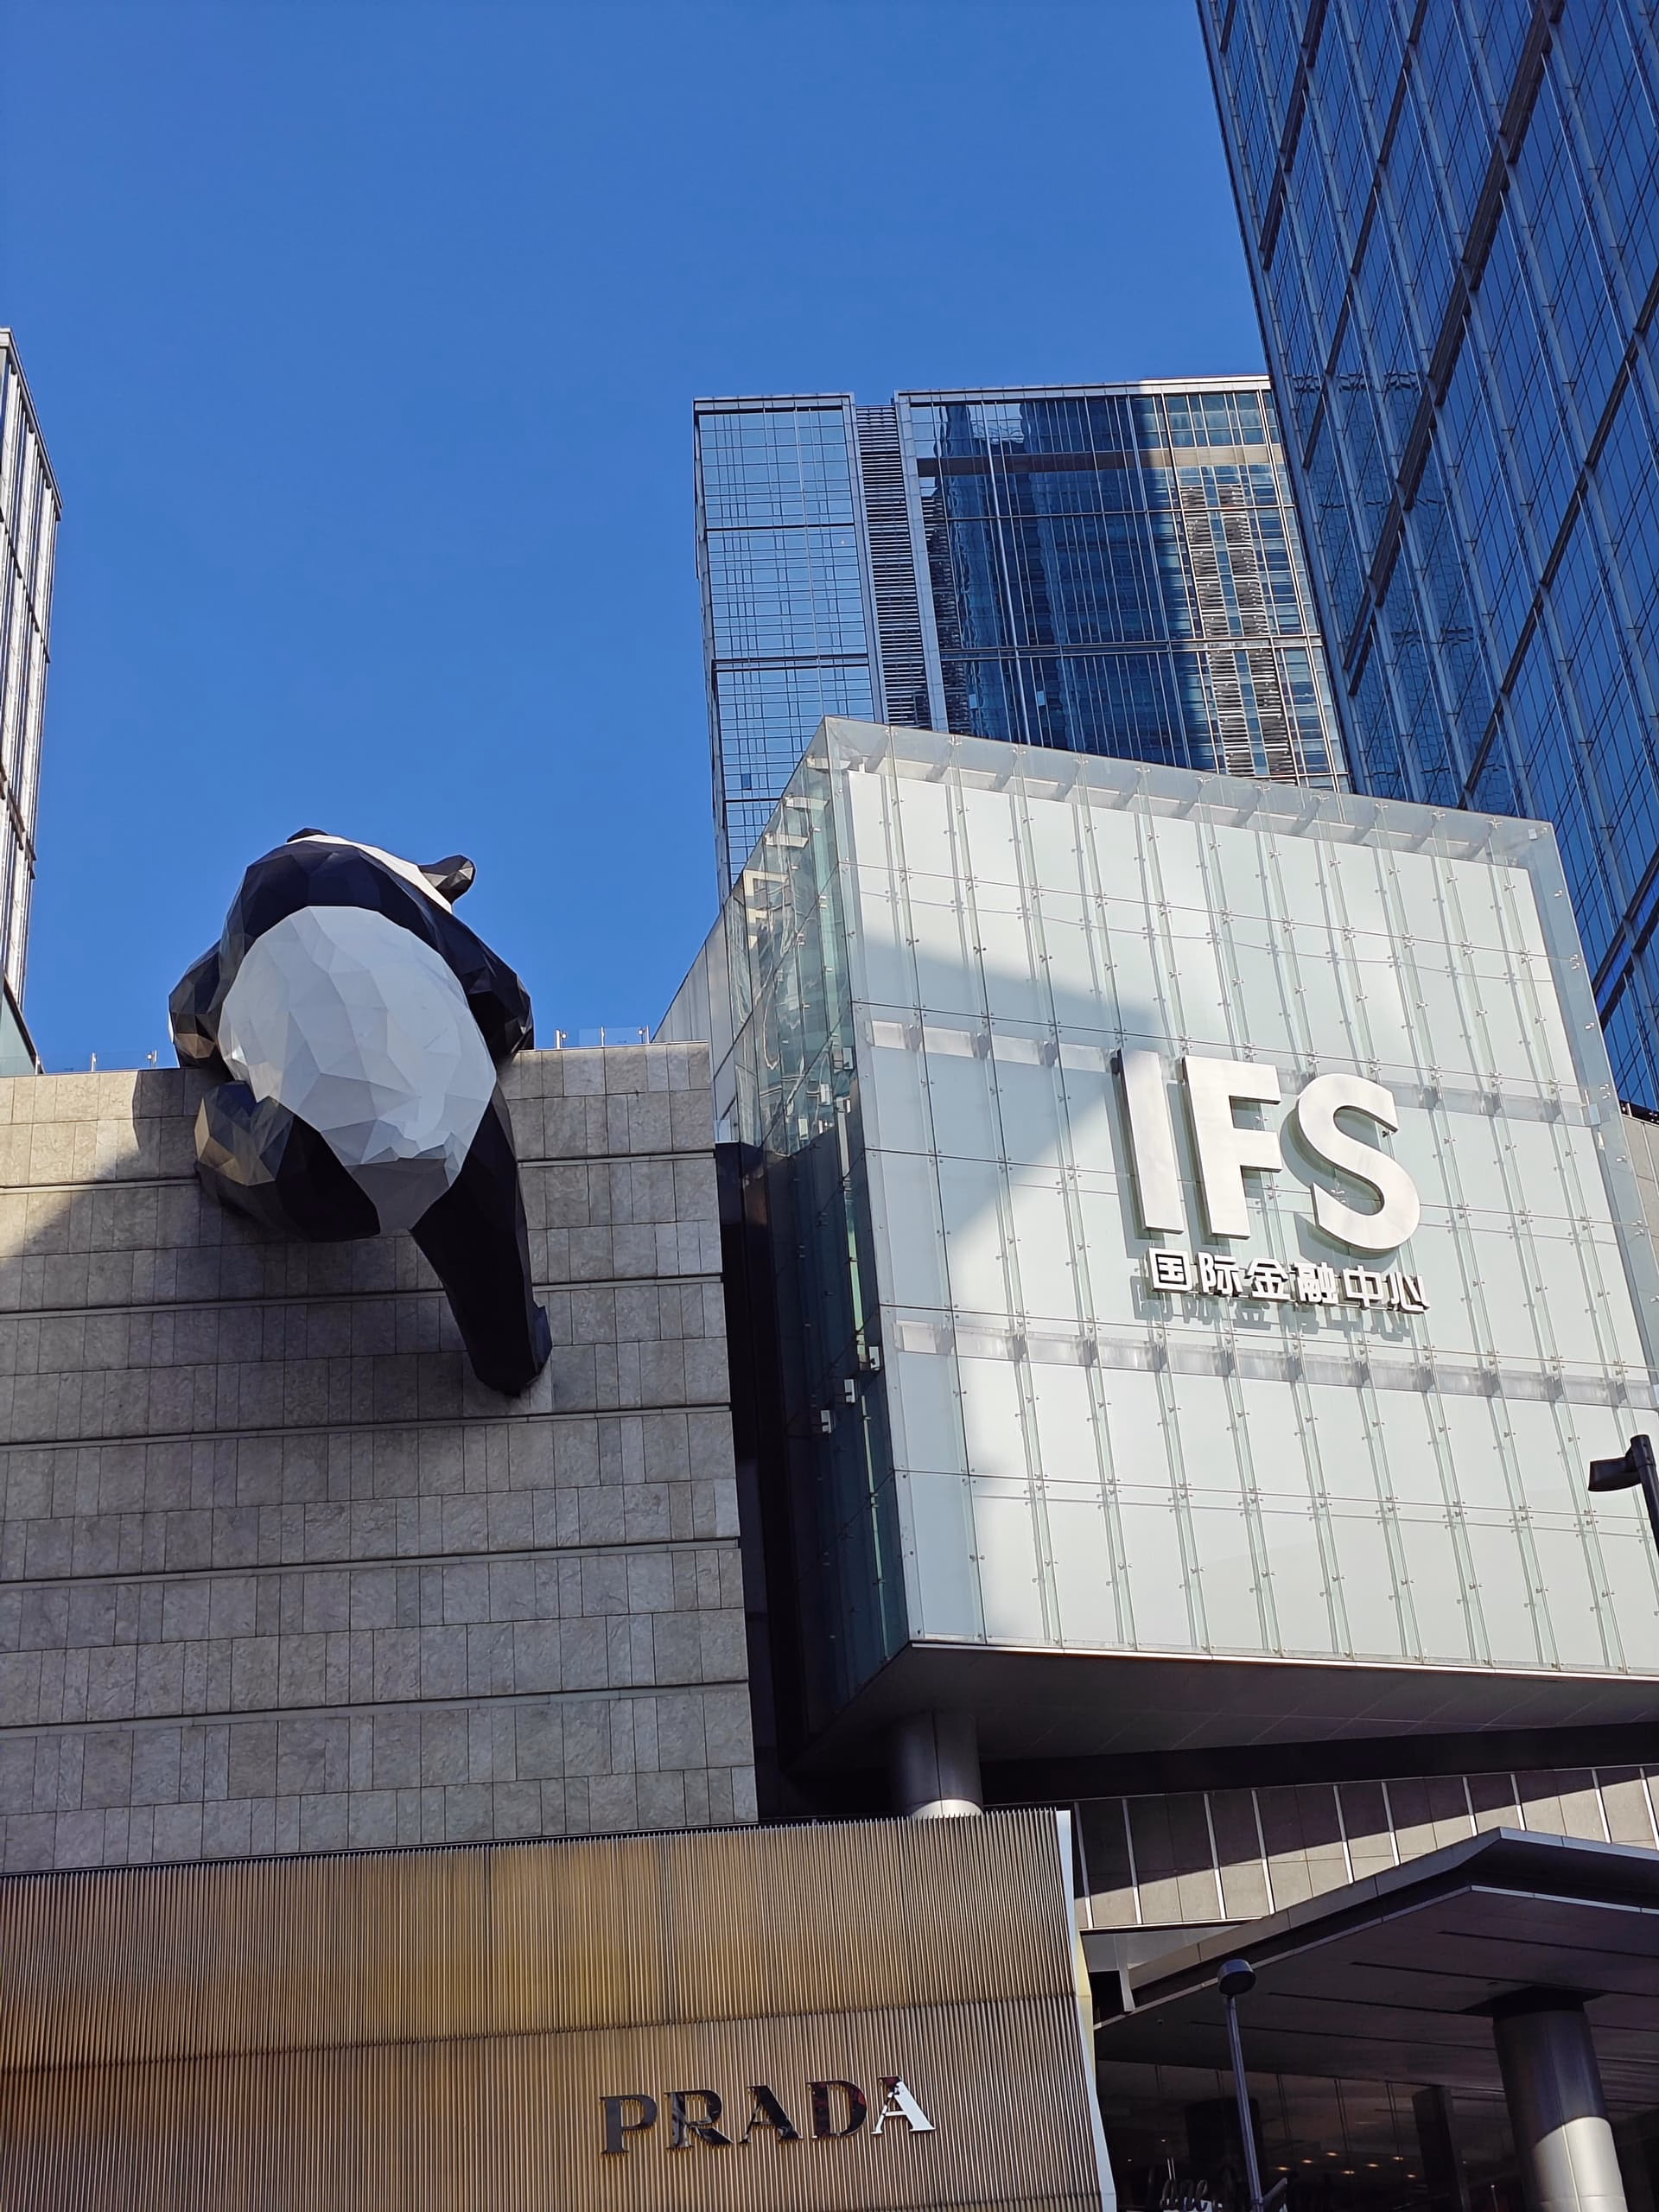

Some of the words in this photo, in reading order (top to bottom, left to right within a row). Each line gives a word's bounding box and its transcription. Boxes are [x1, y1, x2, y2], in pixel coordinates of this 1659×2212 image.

[1118, 1048, 1421, 1249] IFS
[1147, 1248, 1430, 1313] 国际金融中心
[599, 2075, 936, 2155] PRADA
